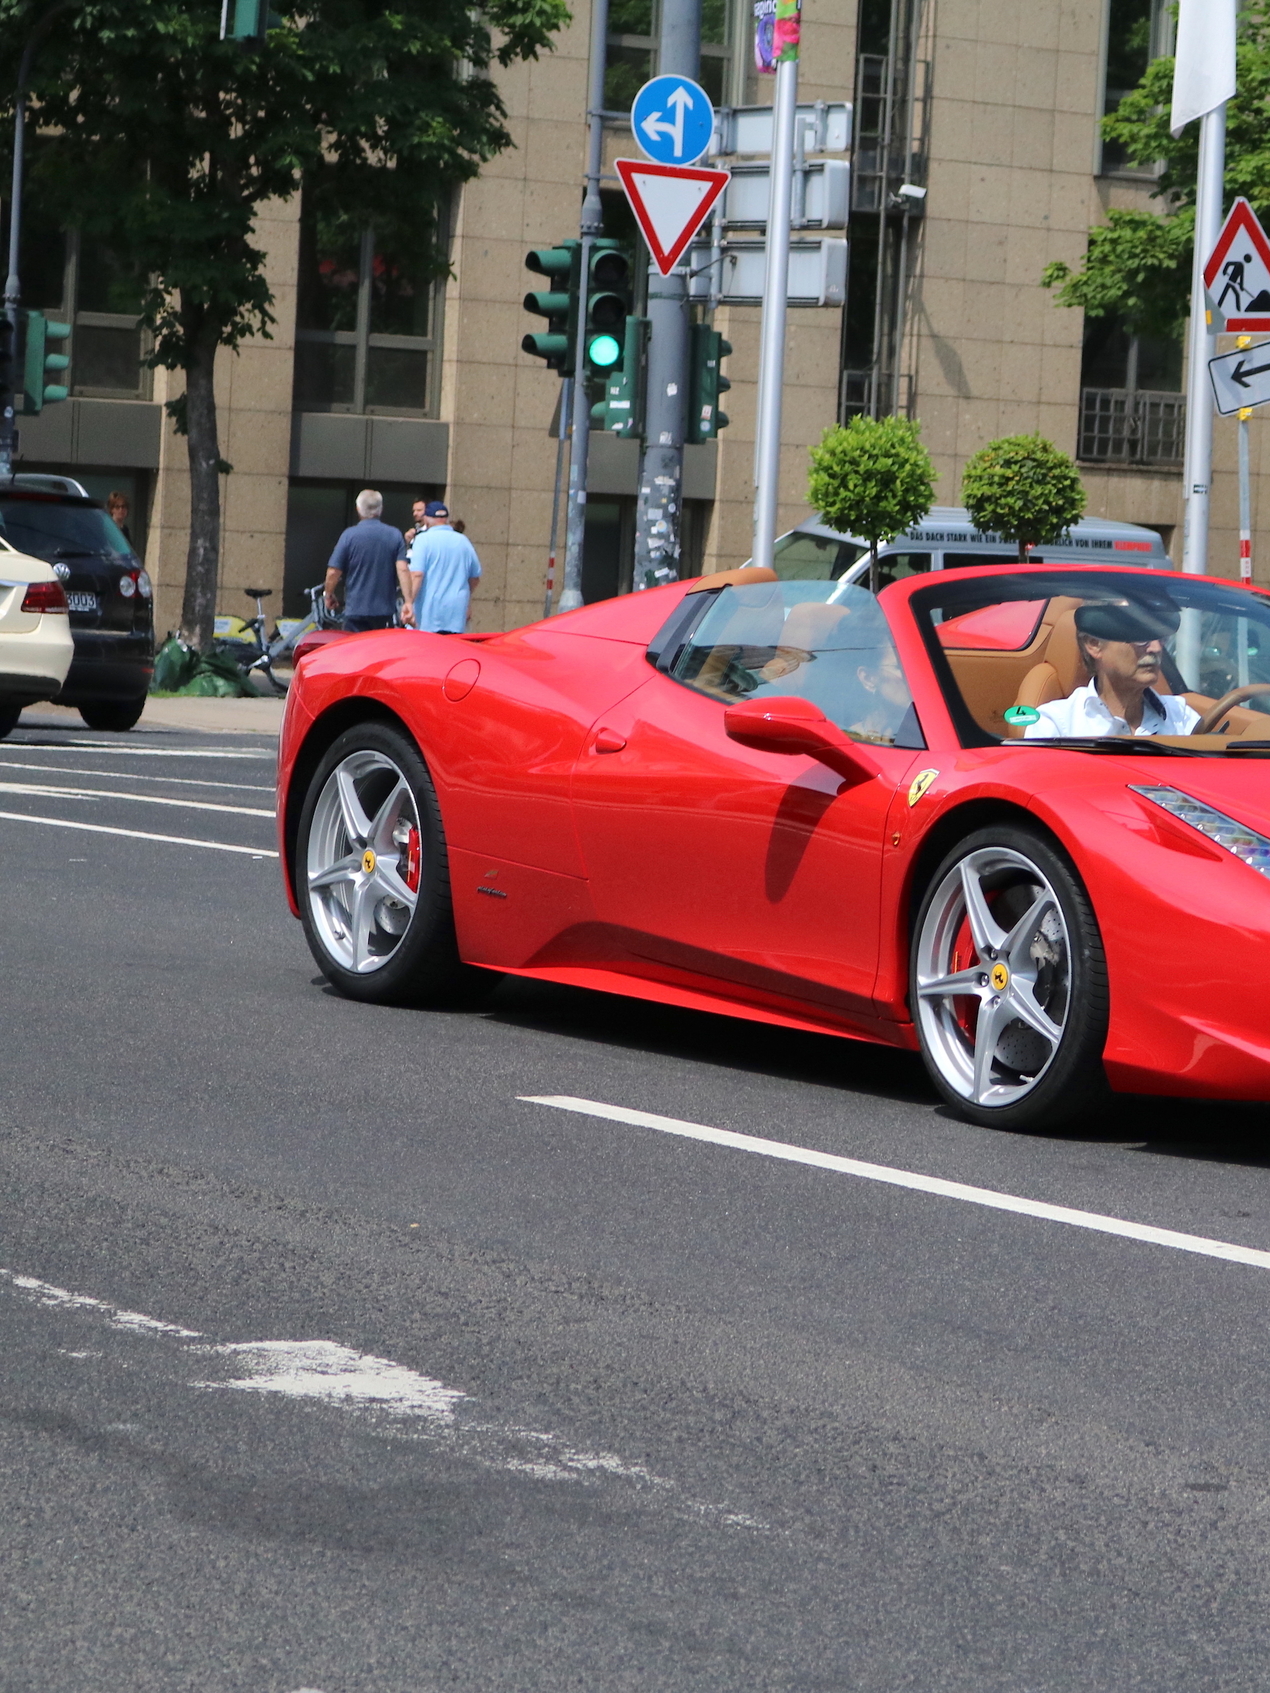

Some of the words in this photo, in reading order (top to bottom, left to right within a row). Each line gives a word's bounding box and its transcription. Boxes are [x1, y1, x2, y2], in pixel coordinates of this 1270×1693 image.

[910, 531, 923, 541] DAS
[926, 532, 945, 541] DACH
[946, 533, 968, 542] STARK
[970, 534, 983, 543] WIE
[985, 534, 997, 544] EIN
[1075, 539, 1090, 548] VON
[1091, 540, 1113, 549] IHREM
[1016, 706, 1026, 716] 4
